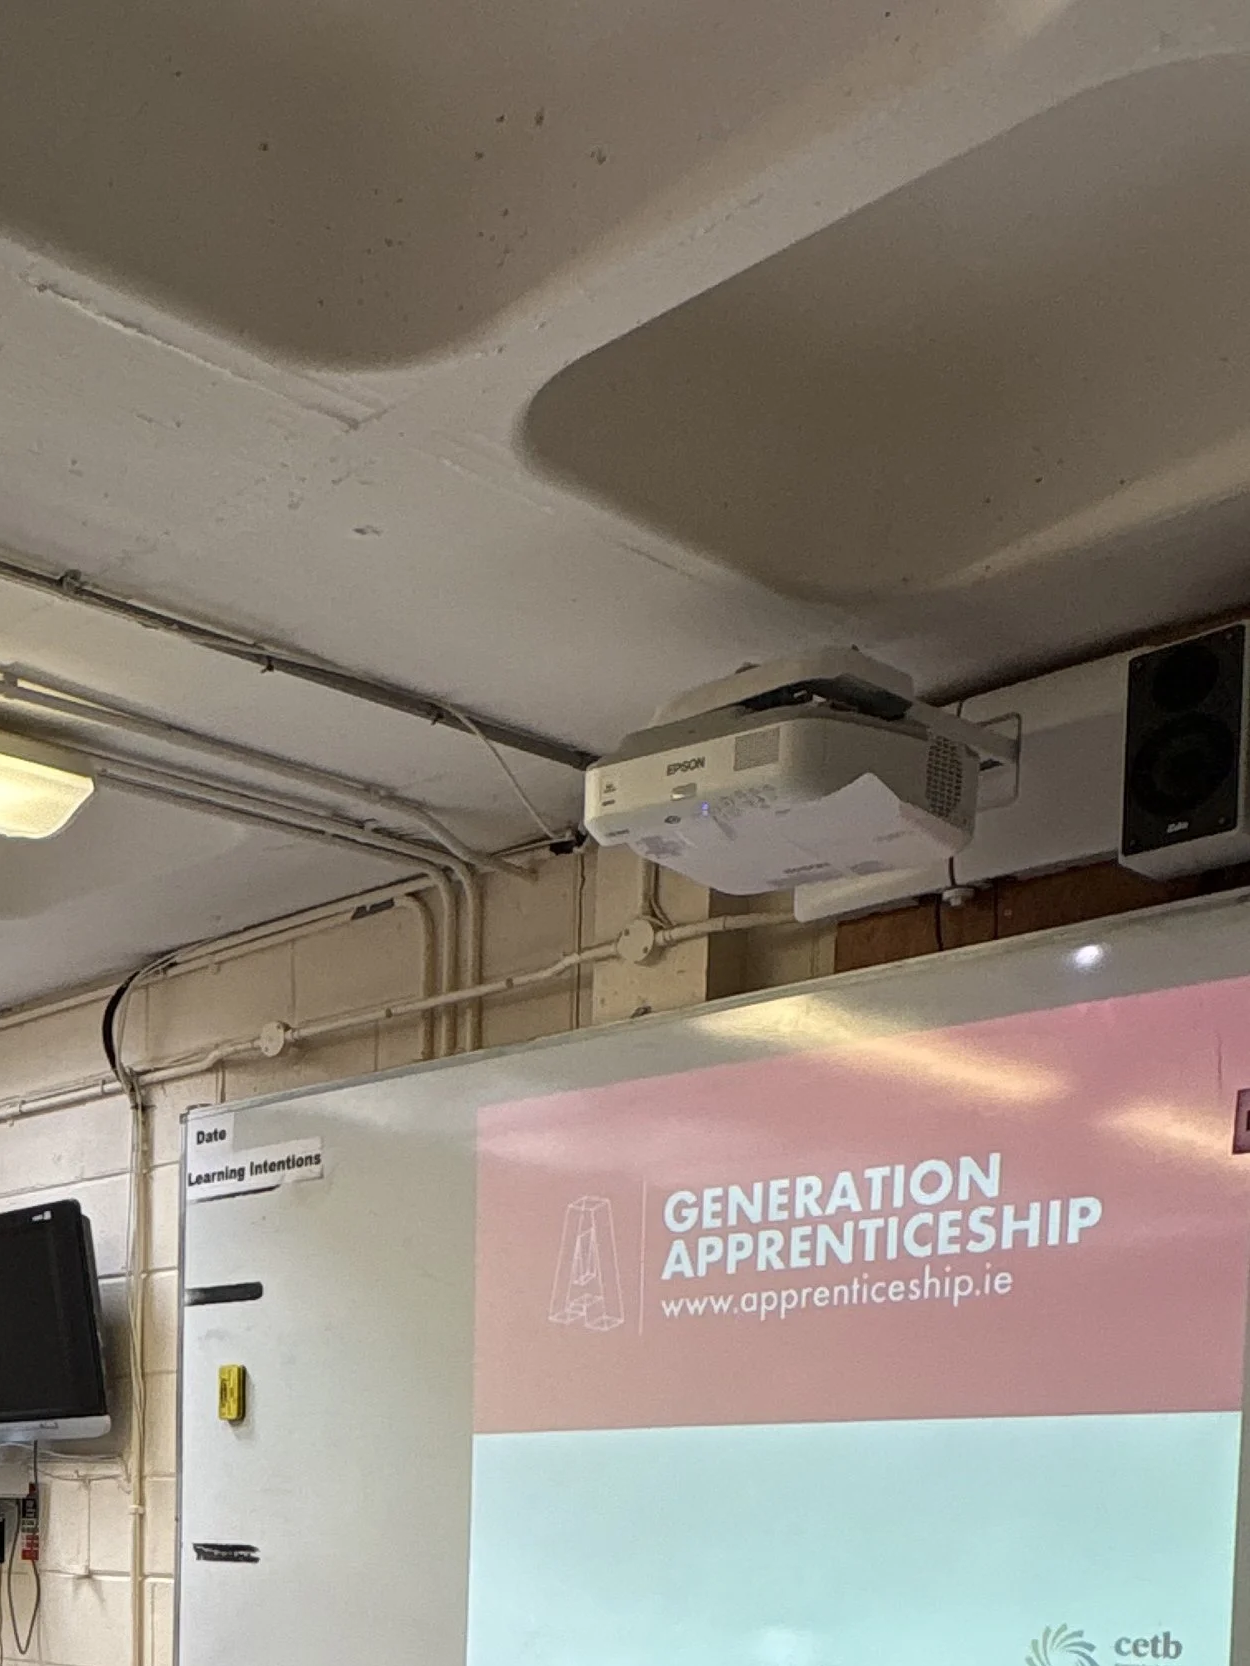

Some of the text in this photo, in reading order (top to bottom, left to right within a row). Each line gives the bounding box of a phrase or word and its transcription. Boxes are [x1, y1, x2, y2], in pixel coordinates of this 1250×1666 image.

[666, 756, 706, 776] EPSON
[196, 1128, 227, 1145] Date
[188, 1153, 322, 1187] Learning Intentions
[663, 1151, 1002, 1233] GENERATION
[660, 1196, 1103, 1281] APPRENTICESHIP
[661, 1262, 1013, 1321] www.apprenticeship.ie
[1114, 1631, 1183, 1660] cetb
